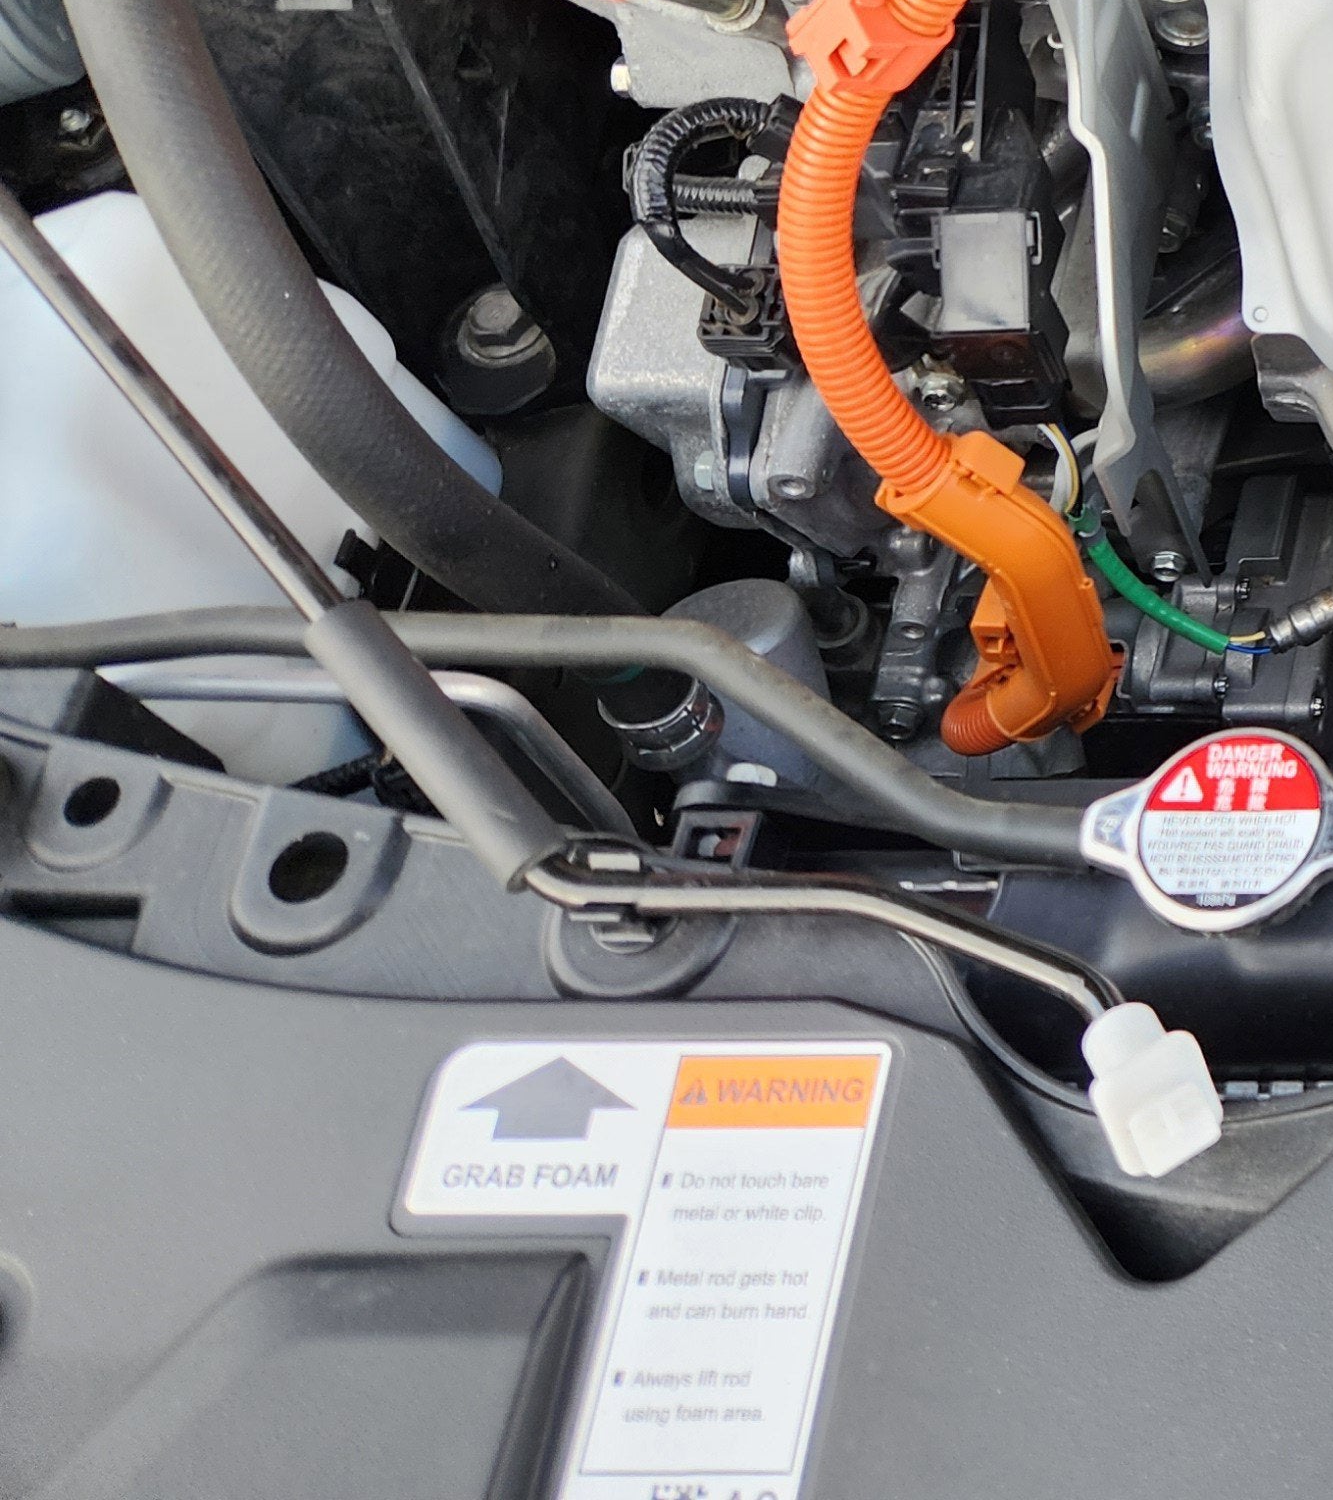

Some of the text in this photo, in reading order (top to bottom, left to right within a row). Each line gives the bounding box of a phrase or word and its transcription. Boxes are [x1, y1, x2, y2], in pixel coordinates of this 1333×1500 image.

[1208, 743, 1284, 760] DANGER
[1206, 759, 1298, 779] WARNUNG
[718, 1078, 865, 1105] WARNING
[441, 1163, 618, 1190] GRAB FOAM
[681, 1172, 830, 1190] Do not touch bare
[673, 1205, 827, 1226] metal or white clip.
[657, 1270, 808, 1291] Metal rod gets hot
[648, 1304, 682, 1320] and
[685, 1307, 716, 1320] can
[720, 1304, 760, 1320] burn
[634, 1370, 751, 1390] Always lift rod
[623, 1405, 765, 1428] using foam area.
